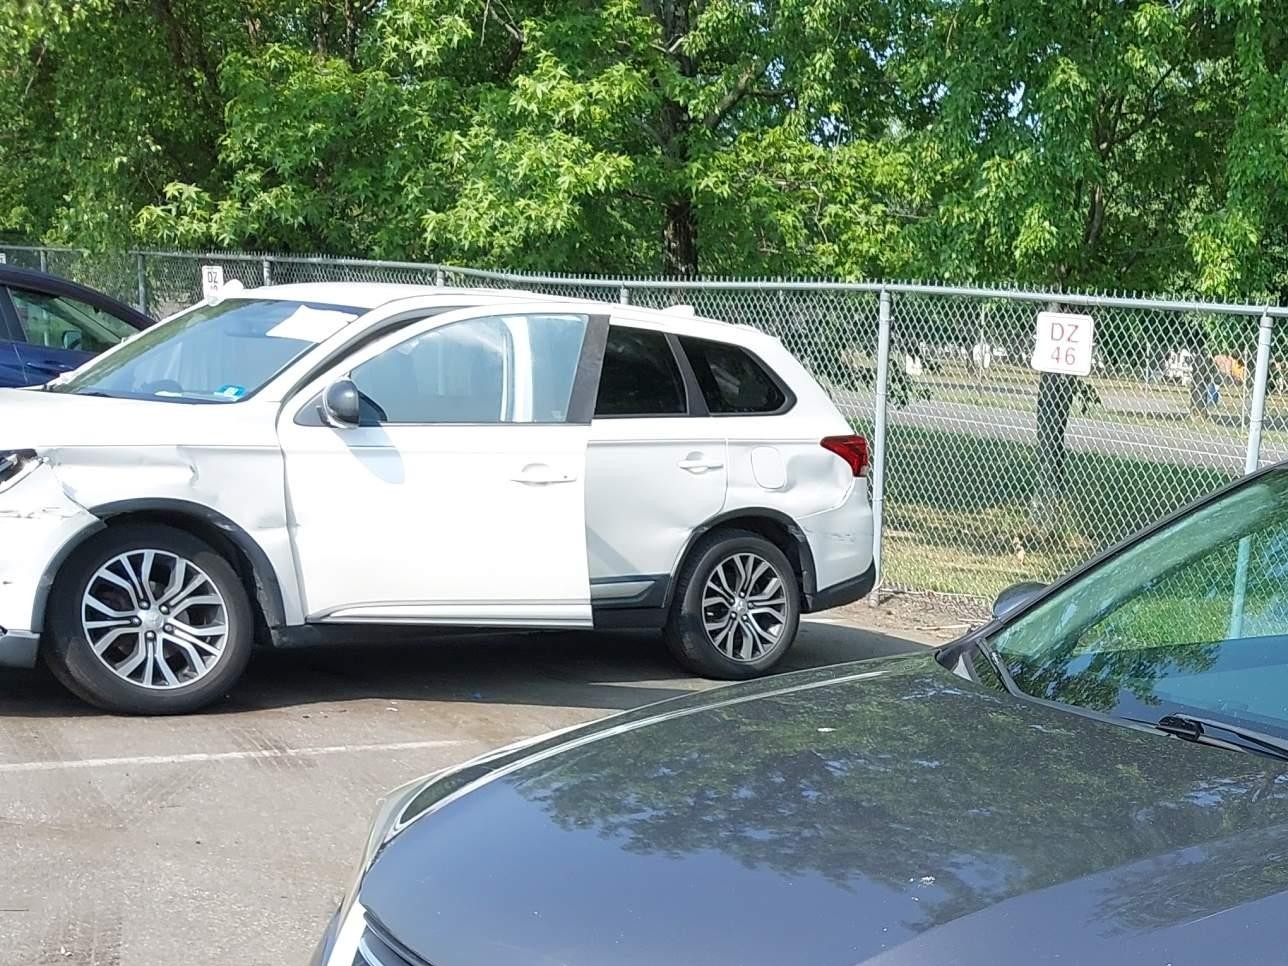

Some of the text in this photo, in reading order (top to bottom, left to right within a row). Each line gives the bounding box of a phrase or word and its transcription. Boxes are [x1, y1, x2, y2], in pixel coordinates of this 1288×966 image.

[208, 271, 218, 283] DZ
[1051, 322, 1080, 343] DZ
[1050, 346, 1076, 366] 46
